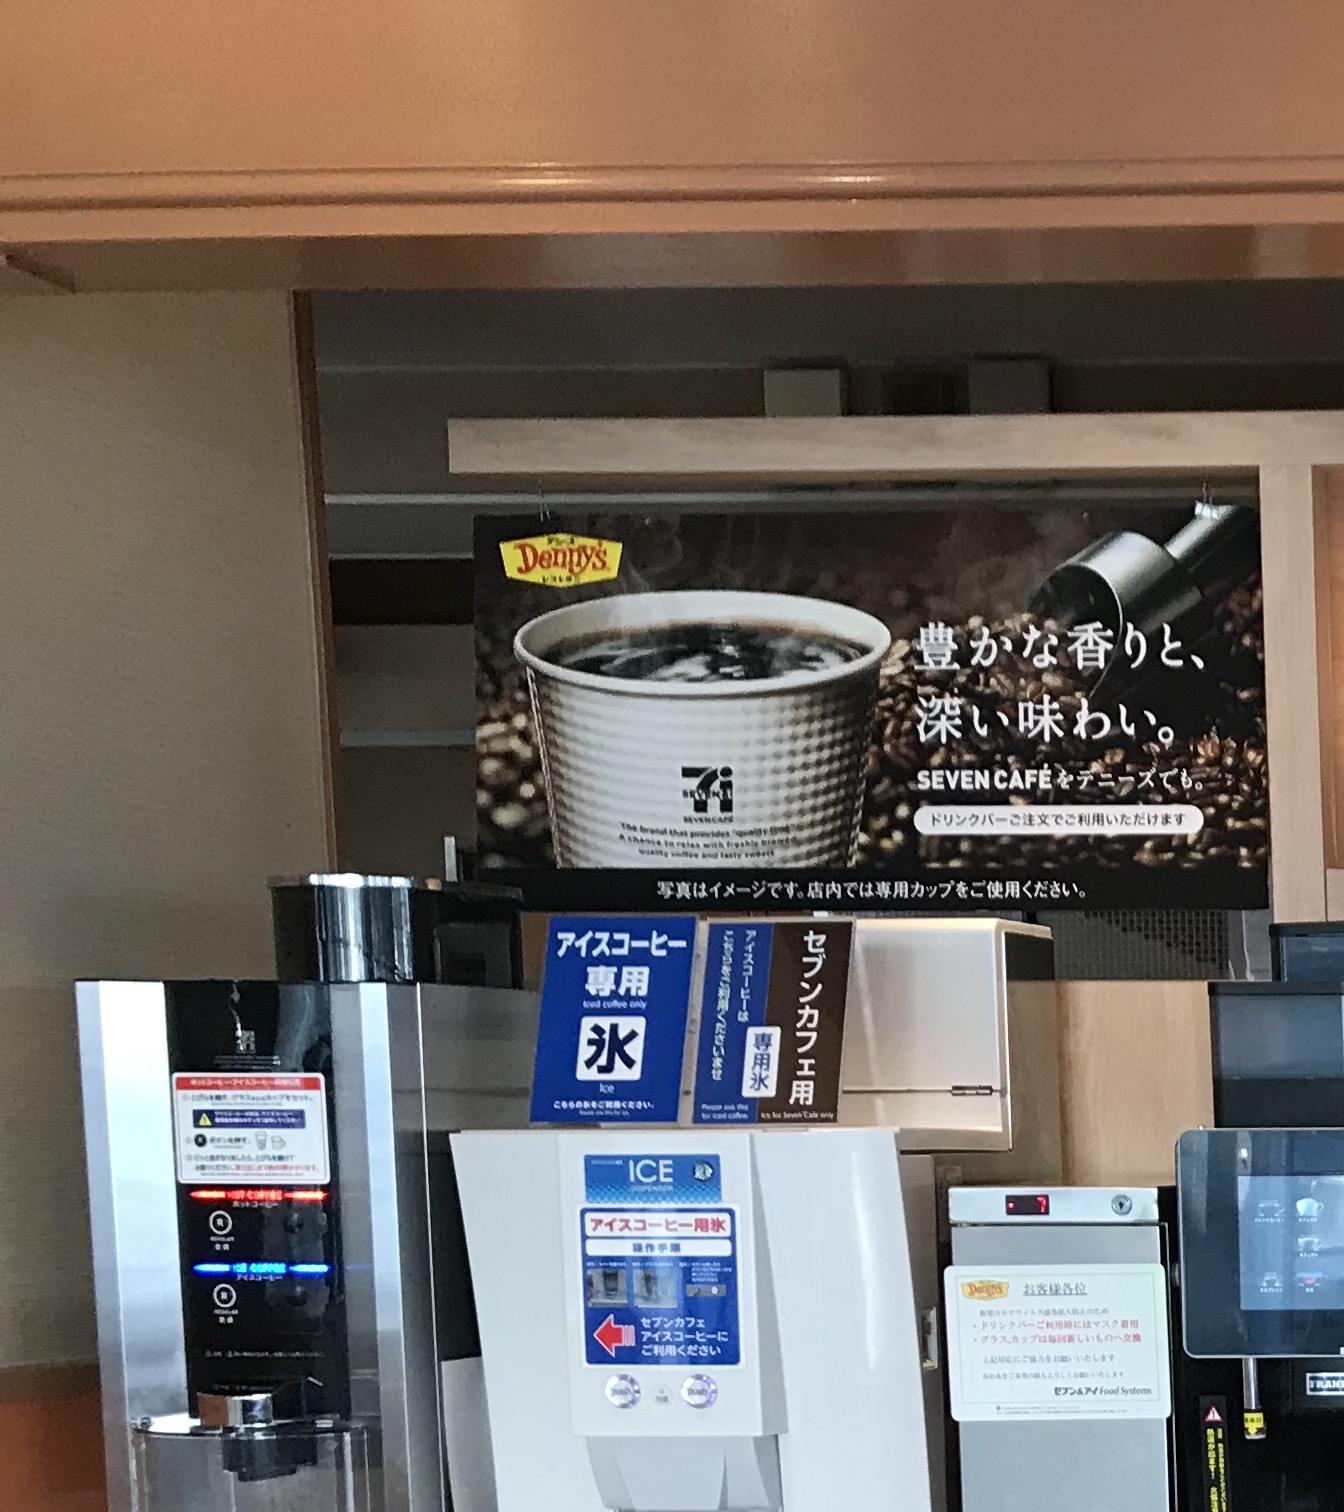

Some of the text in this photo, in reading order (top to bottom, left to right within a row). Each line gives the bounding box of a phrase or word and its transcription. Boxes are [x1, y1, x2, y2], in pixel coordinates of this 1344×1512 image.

[514, 540, 608, 577] Denny's
[913, 621, 1205, 670] 豊かな香りと、
[915, 694, 1175, 744] 深い味わい。
[917, 763, 1203, 793] SEVEN CAFÉ をデニーズでも。
[931, 812, 1185, 827] ドリンクバーご注文でご利用いただけます
[657, 880, 1086, 899] 写真はイメージです。店内では専用カップをご使用ください。
[557, 930, 687, 957] アイスコーヒー
[585, 965, 650, 996] 専用
[603, 1000, 628, 1009] coffee
[630, 1000, 647, 1010] only
[789, 929, 827, 1106] セブンカフェ用
[584, 1023, 639, 1074] 氷
[750, 1032, 773, 1091] 専用氷
[629, 1160, 673, 1182] ICE
[590, 1218, 726, 1233] アイスコーヒー用氷
[1023, 1282, 1087, 1296] お客様各位
[640, 1317, 705, 1328] セブンカフェ
[640, 1331, 729, 1341] アイスコーヒーに
[641, 1344, 721, 1357] ご利用ください
[1099, 1386, 1119, 1395] Food
[1121, 1386, 1152, 1397] Systems
